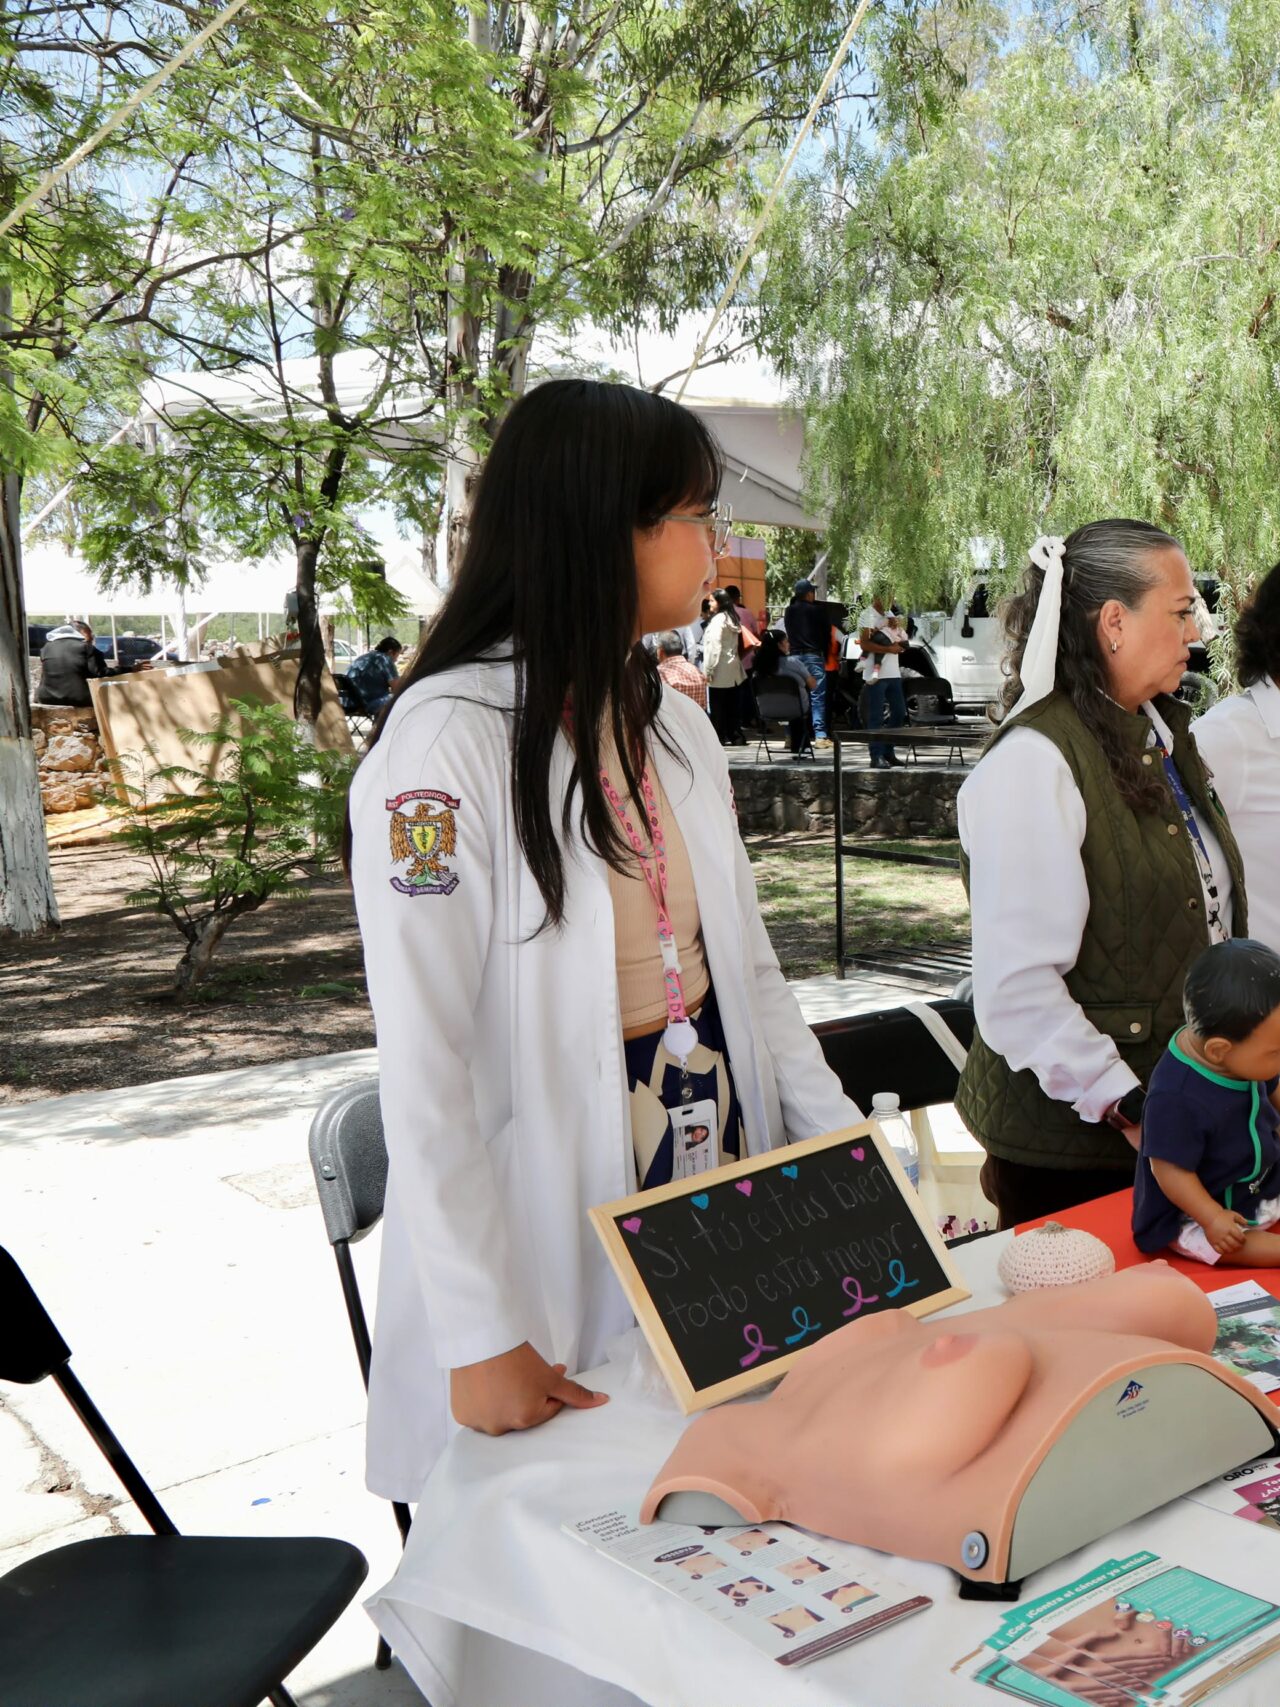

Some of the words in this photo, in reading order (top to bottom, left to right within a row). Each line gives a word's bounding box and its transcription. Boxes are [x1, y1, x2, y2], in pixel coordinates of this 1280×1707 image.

[823, 1162, 894, 1210] bien
[664, 1275, 749, 1335] todo
[1223, 1467, 1255, 1482] QRO
[1026, 1597, 1064, 1619] ¡Contra
[1063, 1590, 1075, 1598] el
[1074, 1574, 1108, 1592] cáncer
